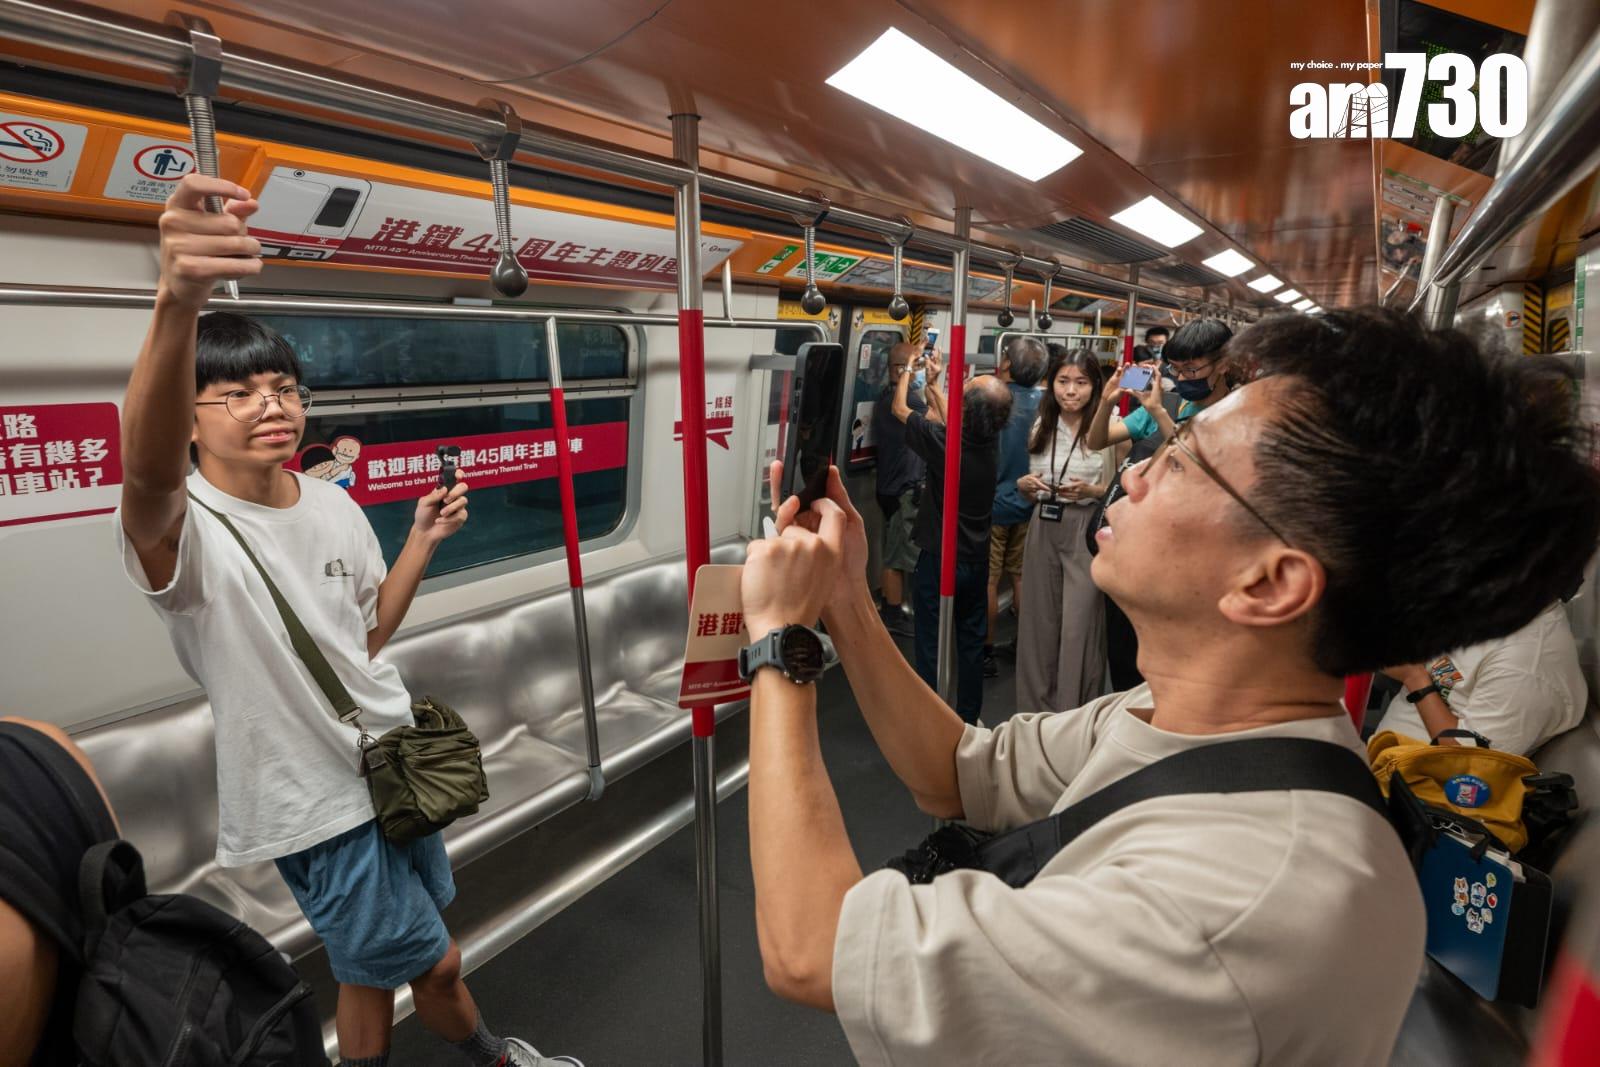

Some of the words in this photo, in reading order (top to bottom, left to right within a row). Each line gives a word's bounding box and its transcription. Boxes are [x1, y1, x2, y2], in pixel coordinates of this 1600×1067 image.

[0, 165, 48, 178] 勿吸煙
[364, 244, 387, 252] MTR
[408, 249, 458, 260] Anniversary
[0, 413, 38, 439] 路
[0, 438, 109, 469] 有幾多
[367, 438, 583, 479] 歡迎乘搭鐵45周年主題車
[367, 481, 403, 492] Welcome
[414, 477, 427, 486] the
[427, 475, 440, 483] MT
[463, 467, 499, 478] nniversary
[499, 464, 523, 474] Themed
[523, 462, 539, 470] Train
[697, 612, 746, 637] 港鐵
